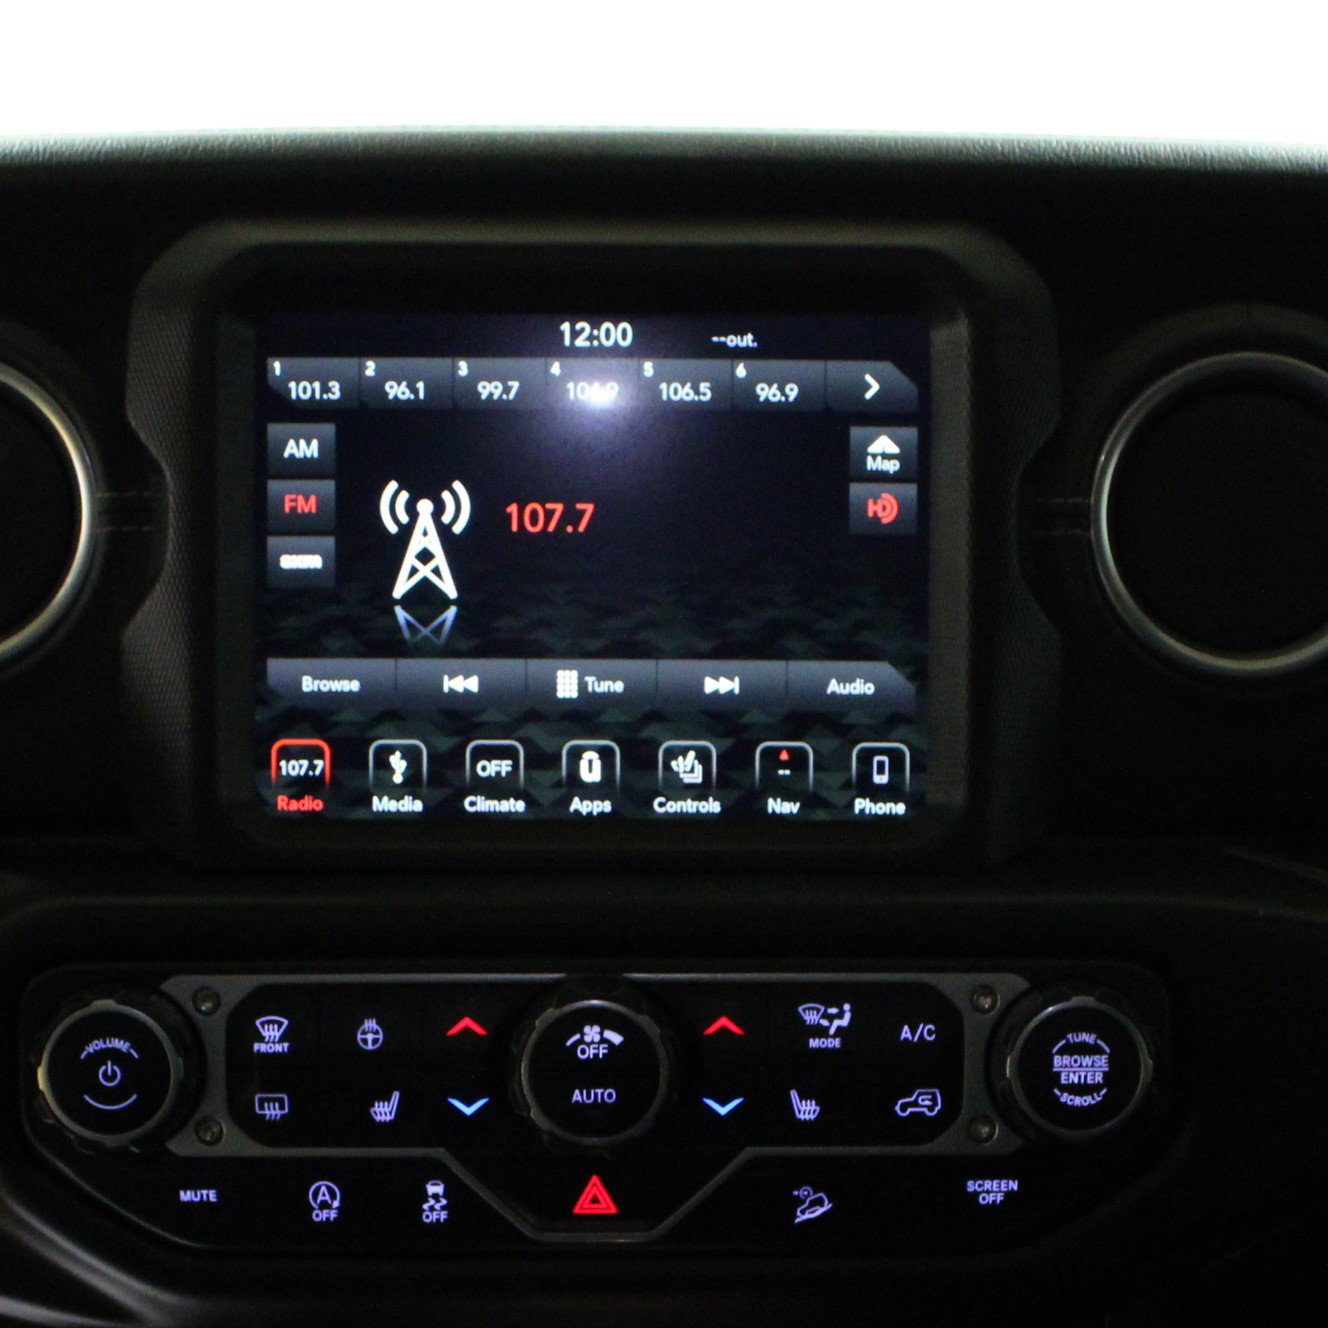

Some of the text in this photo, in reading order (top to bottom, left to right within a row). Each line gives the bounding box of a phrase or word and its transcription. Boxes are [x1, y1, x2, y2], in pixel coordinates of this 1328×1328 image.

[559, 321, 634, 349] 12:00
[272, 360, 282, 377] 1
[364, 360, 376, 378] 2
[457, 360, 469, 378] 3
[549, 361, 562, 377] 4
[642, 361, 655, 379] 5
[735, 362, 747, 379] 6
[287, 380, 342, 401] 101.3
[384, 380, 426, 401] 96.1
[477, 380, 521, 401] 99.7
[658, 381, 712, 402] 106.5
[755, 382, 799, 403] 96.9
[283, 438, 320, 459] AM
[866, 455, 901, 475] Map
[283, 493, 317, 514] FM
[505, 501, 595, 533] 107.7
[301, 675, 361, 693] Browse
[583, 675, 625, 694] Tune
[826, 677, 876, 696] Audio
[279, 759, 325, 777] 107.7
[476, 759, 513, 778] OFF
[276, 794, 325, 812] Radio
[372, 795, 424, 813] Media
[463, 795, 527, 813] Climate
[568, 796, 613, 817] Apps
[652, 796, 722, 815] Controls
[767, 797, 801, 815] Nav
[853, 797, 907, 816] Phone
[899, 1023, 936, 1043] A/C
[1066, 1032, 1097, 1044] TUNE
[85, 1037, 131, 1053] VOLUME
[253, 1042, 290, 1054] FRONT
[575, 1043, 610, 1060] OFF
[808, 1037, 841, 1049] MODE
[1052, 1055, 1109, 1067] BROWSE
[1060, 1072, 1104, 1085] ENTER
[571, 1088, 617, 1104] AUTO
[1060, 1092, 1102, 1106] SCROLL
[966, 1179, 1019, 1192] SCREEN
[179, 1189, 218, 1203] MUTE
[978, 1193, 1005, 1205] OFF
[311, 1209, 339, 1223] OFF
[422, 1211, 449, 1224] OFF
